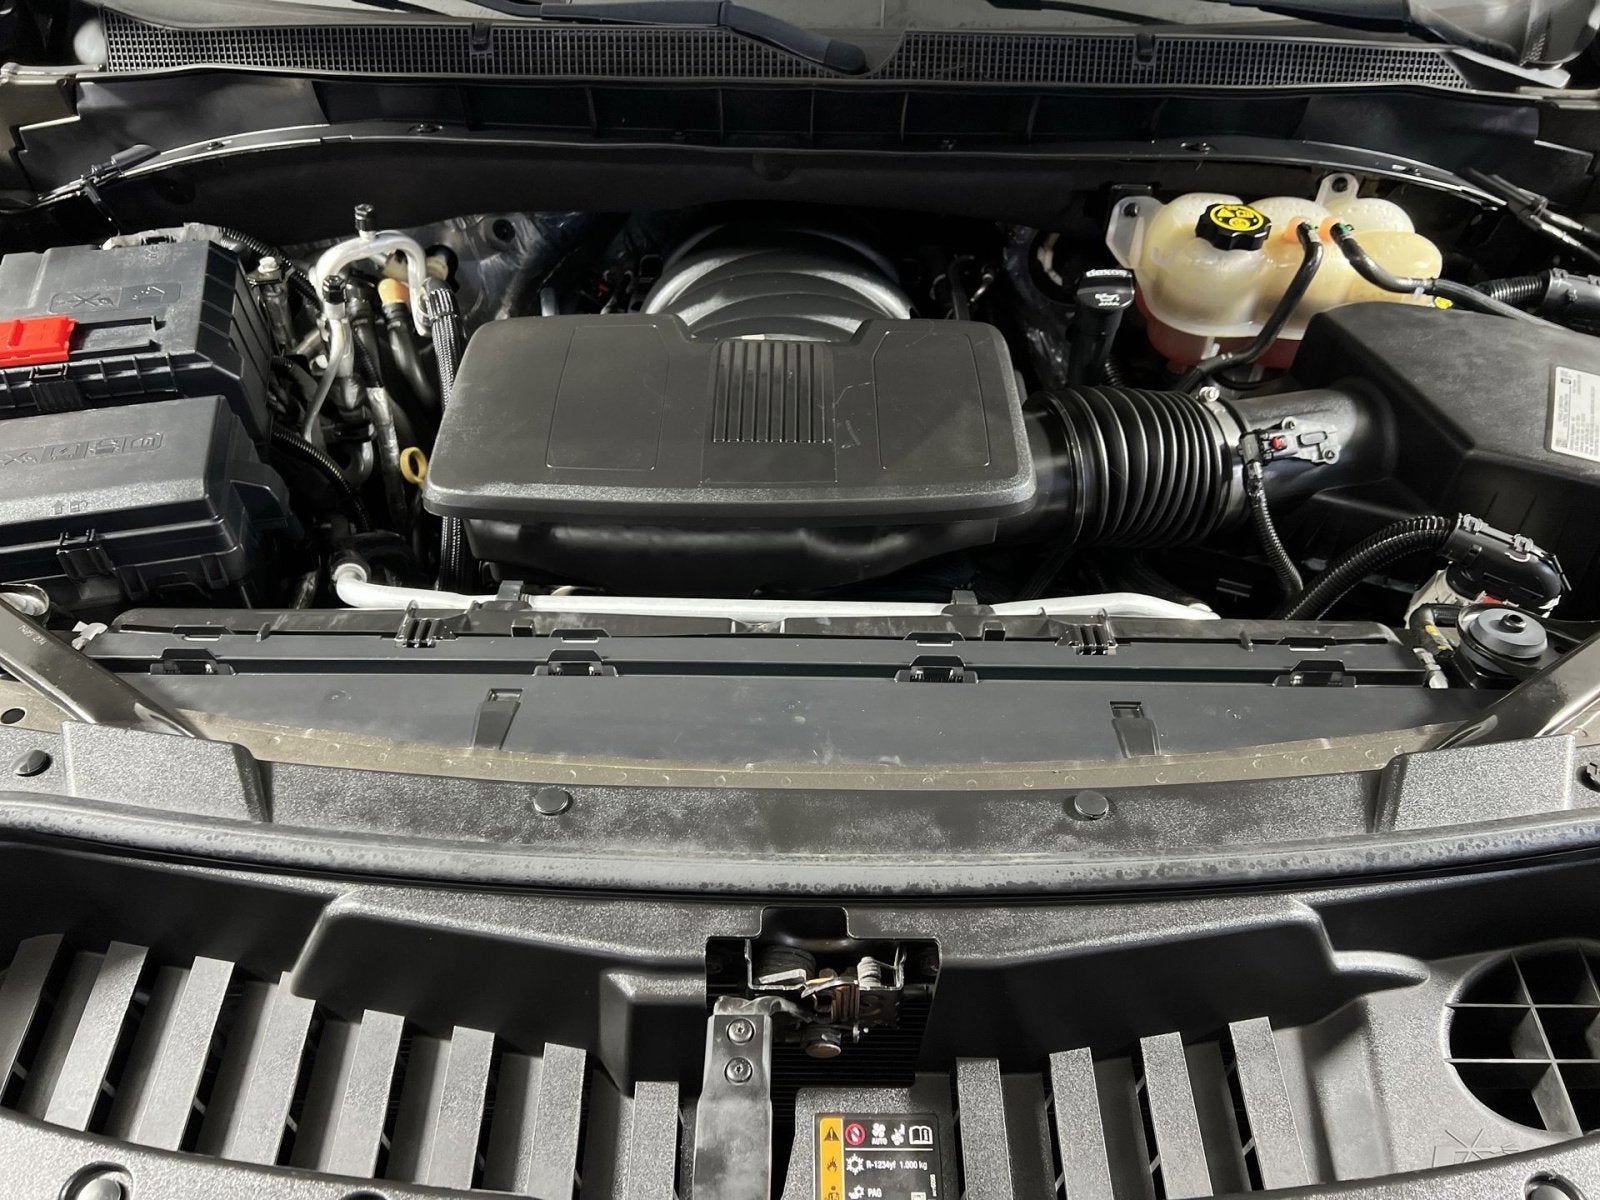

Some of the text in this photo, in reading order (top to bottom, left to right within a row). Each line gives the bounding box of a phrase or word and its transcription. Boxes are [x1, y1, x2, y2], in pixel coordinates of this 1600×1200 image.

[866, 1160, 928, 1171] R-1234yf 1.000 kg
[867, 1188, 882, 1198] PAG
